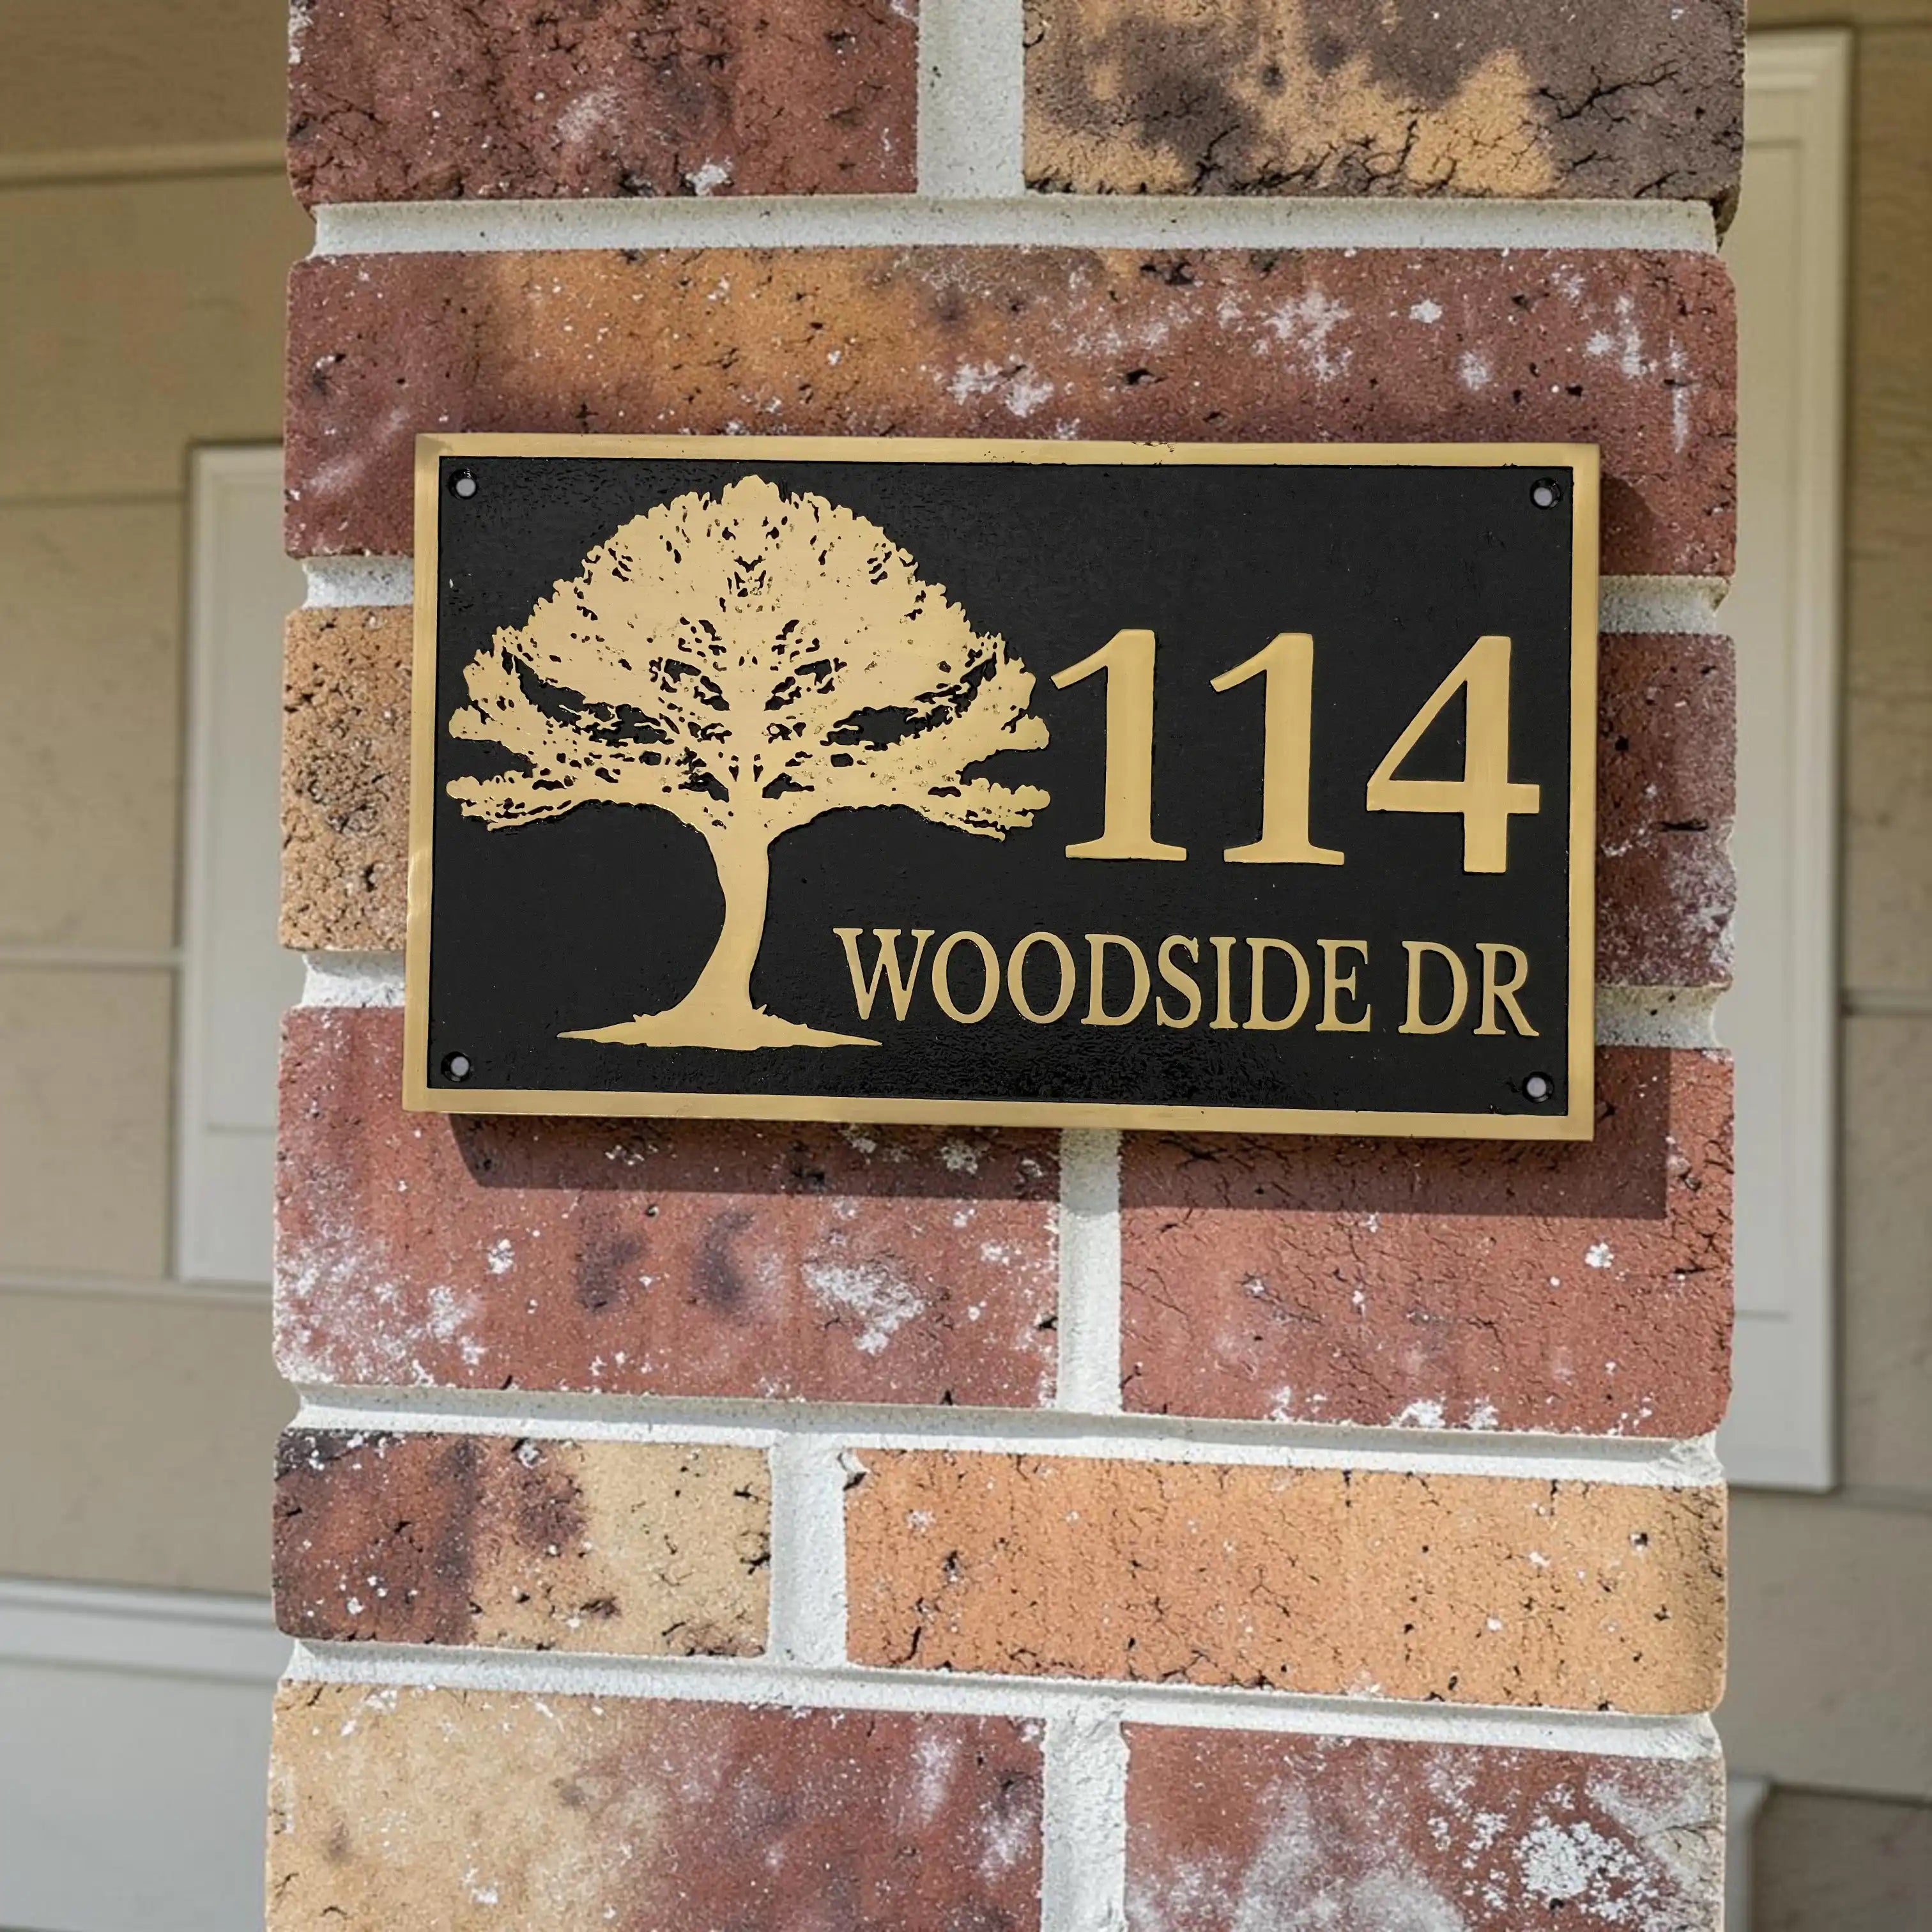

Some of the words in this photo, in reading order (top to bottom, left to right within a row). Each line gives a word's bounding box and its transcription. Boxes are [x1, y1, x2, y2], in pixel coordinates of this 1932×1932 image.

[1051, 629, 1541, 874] 114
[832, 928, 1371, 1032] WOODSIDE
[1398, 940, 1540, 1037] DR
